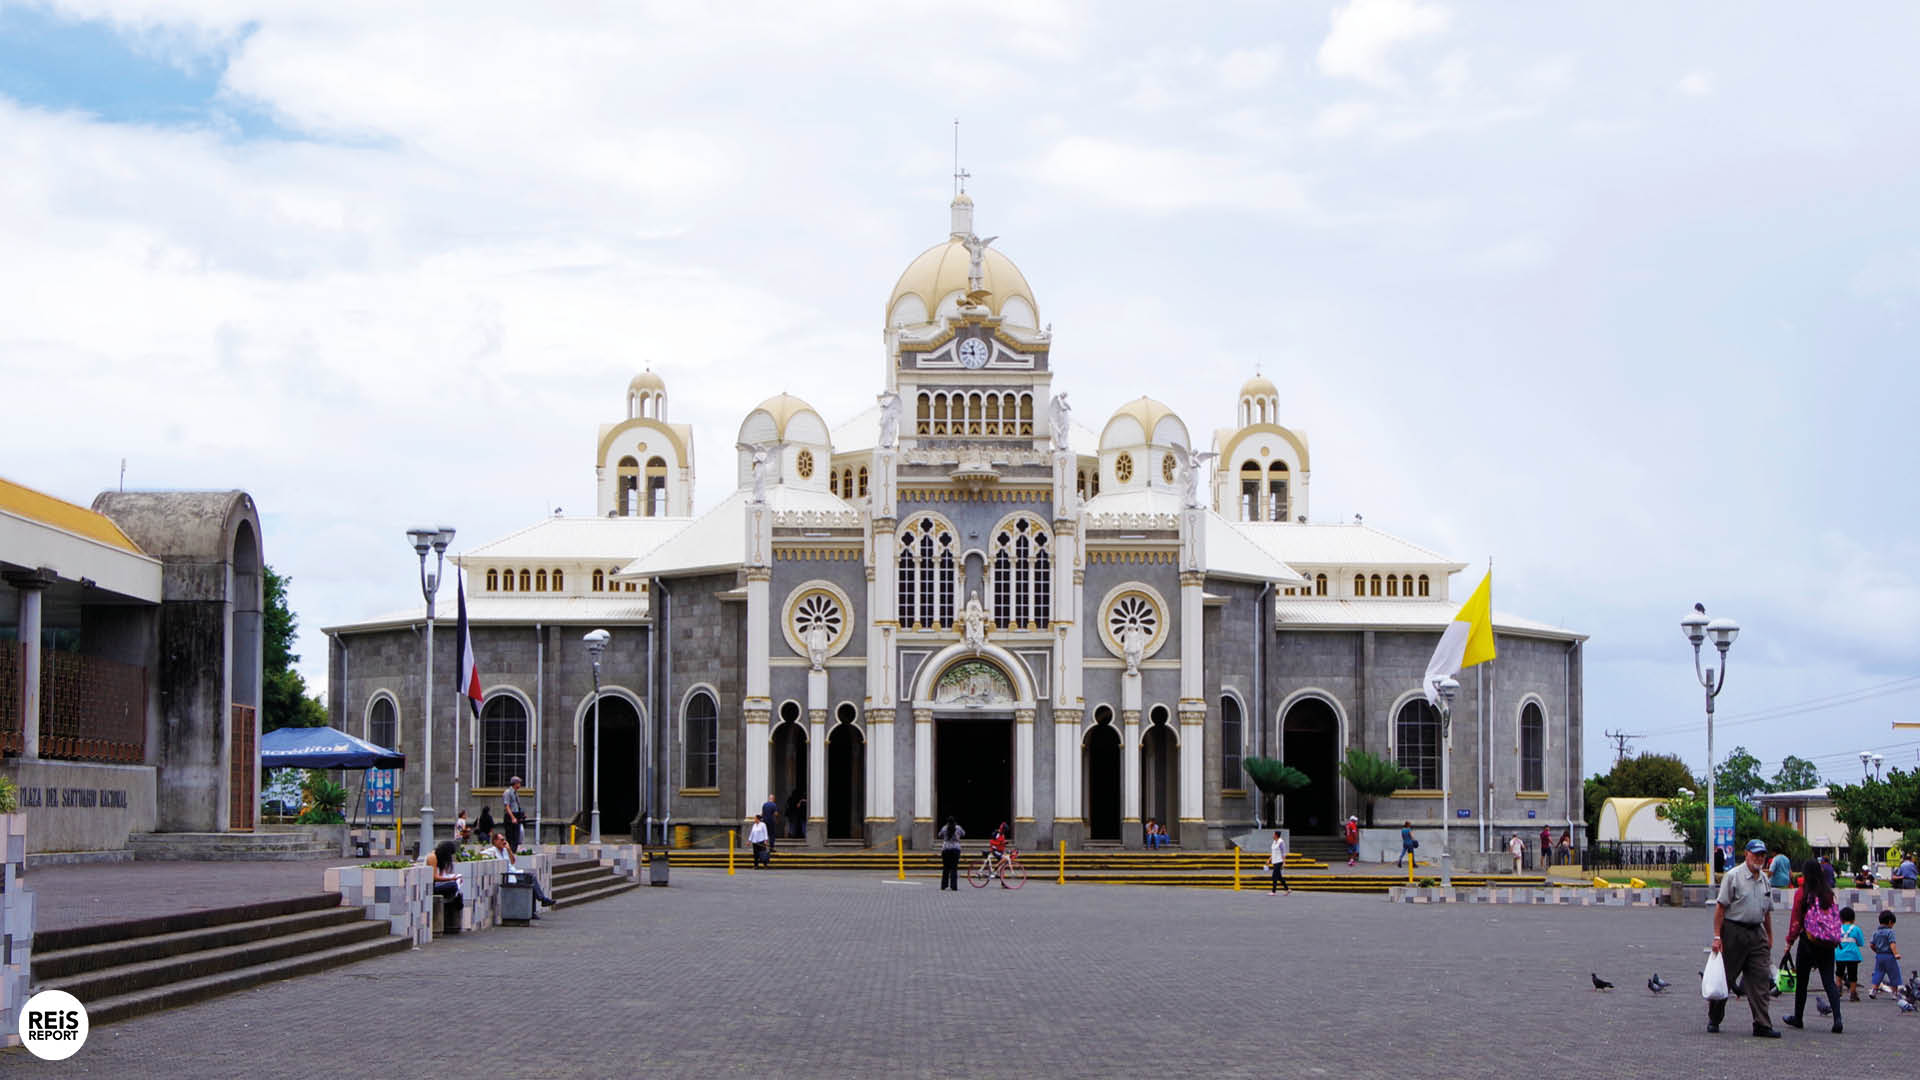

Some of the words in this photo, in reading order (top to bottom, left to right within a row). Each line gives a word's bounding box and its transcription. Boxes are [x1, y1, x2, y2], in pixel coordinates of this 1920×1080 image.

[20, 787, 42, 808] PLAZA
[46, 787, 59, 808] DEL
[62, 788, 97, 808] SANTUARIO
[100, 789, 128, 809] NACIONAL
